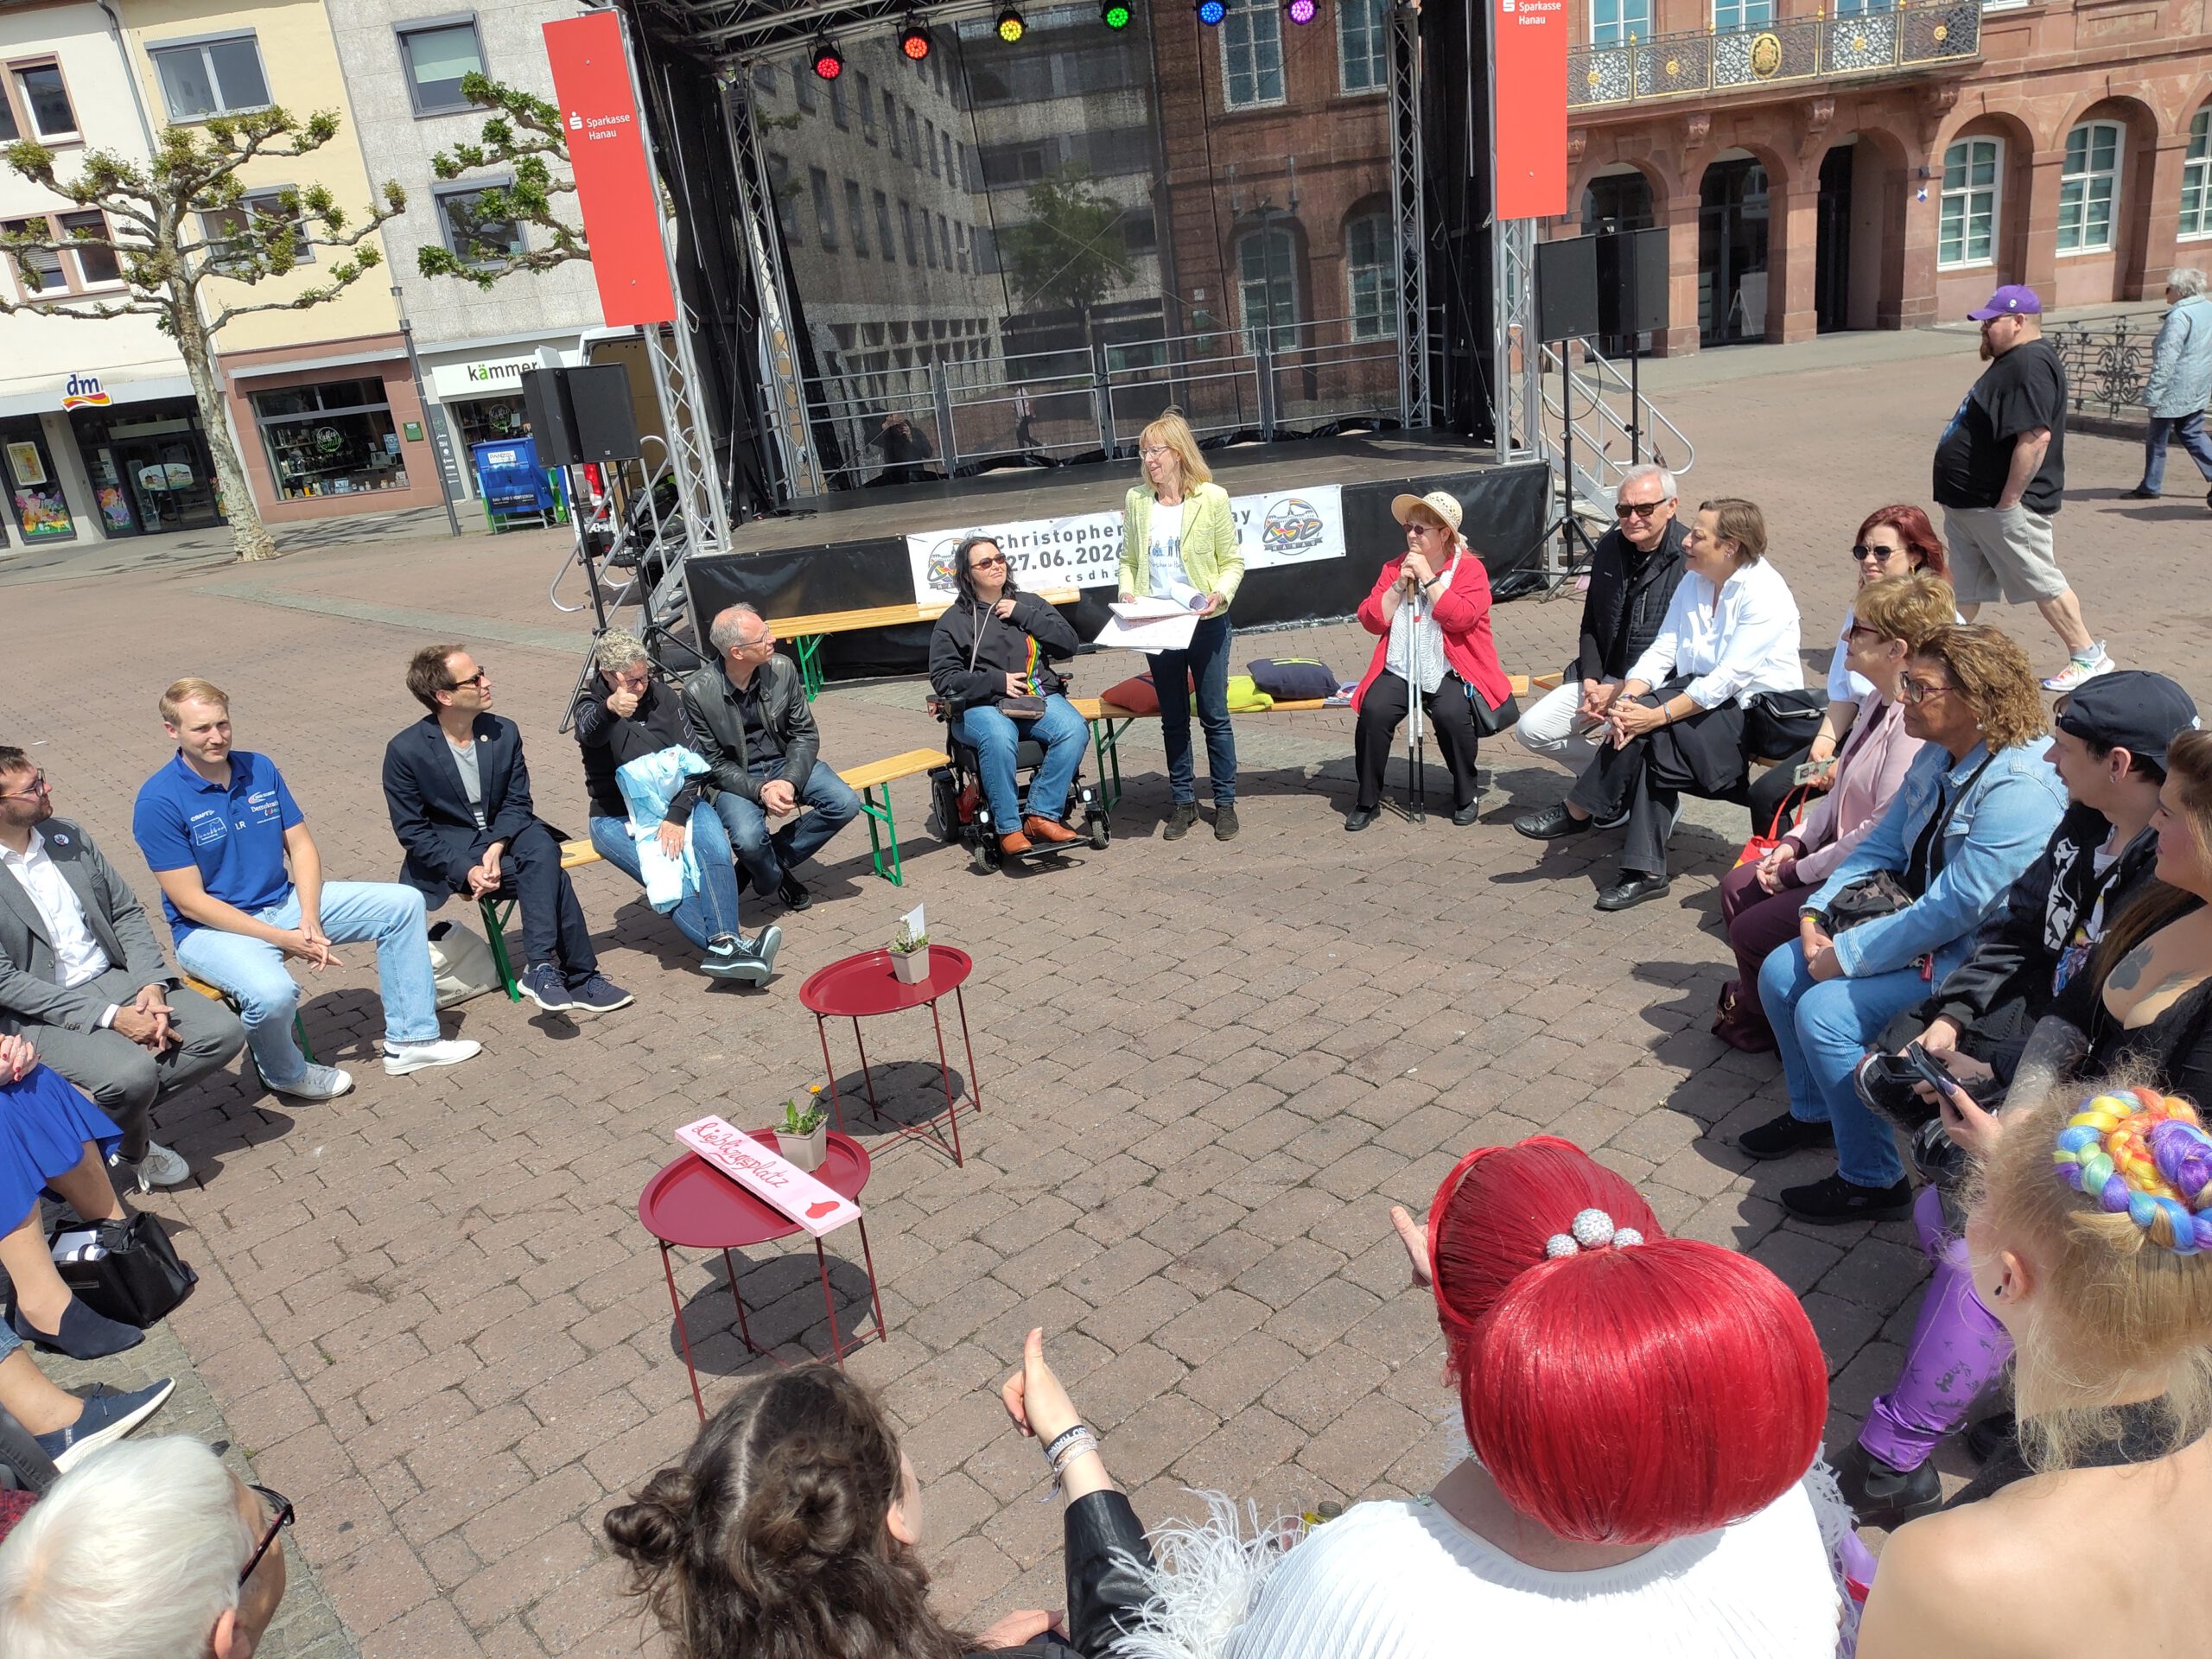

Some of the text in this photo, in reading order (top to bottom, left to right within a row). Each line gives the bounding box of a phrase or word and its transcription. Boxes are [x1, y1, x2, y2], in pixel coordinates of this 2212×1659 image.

[1518, 1, 1561, 13] Sparkasse
[1518, 16, 1546, 25] Hanau
[586, 114, 630, 129] Sparkasse
[588, 130, 617, 140] Hanau
[67, 373, 100, 397] dm
[994, 509, 1251, 550] Christopher ay
[1262, 518, 1324, 543] CSD
[1272, 541, 1317, 551] HANAU
[1006, 542, 1122, 571] 27.06.2026
[190, 810, 209, 822] CRAFT
[234, 820, 246, 830] LR
[691, 1122, 789, 1188] Lieblingsplatz
